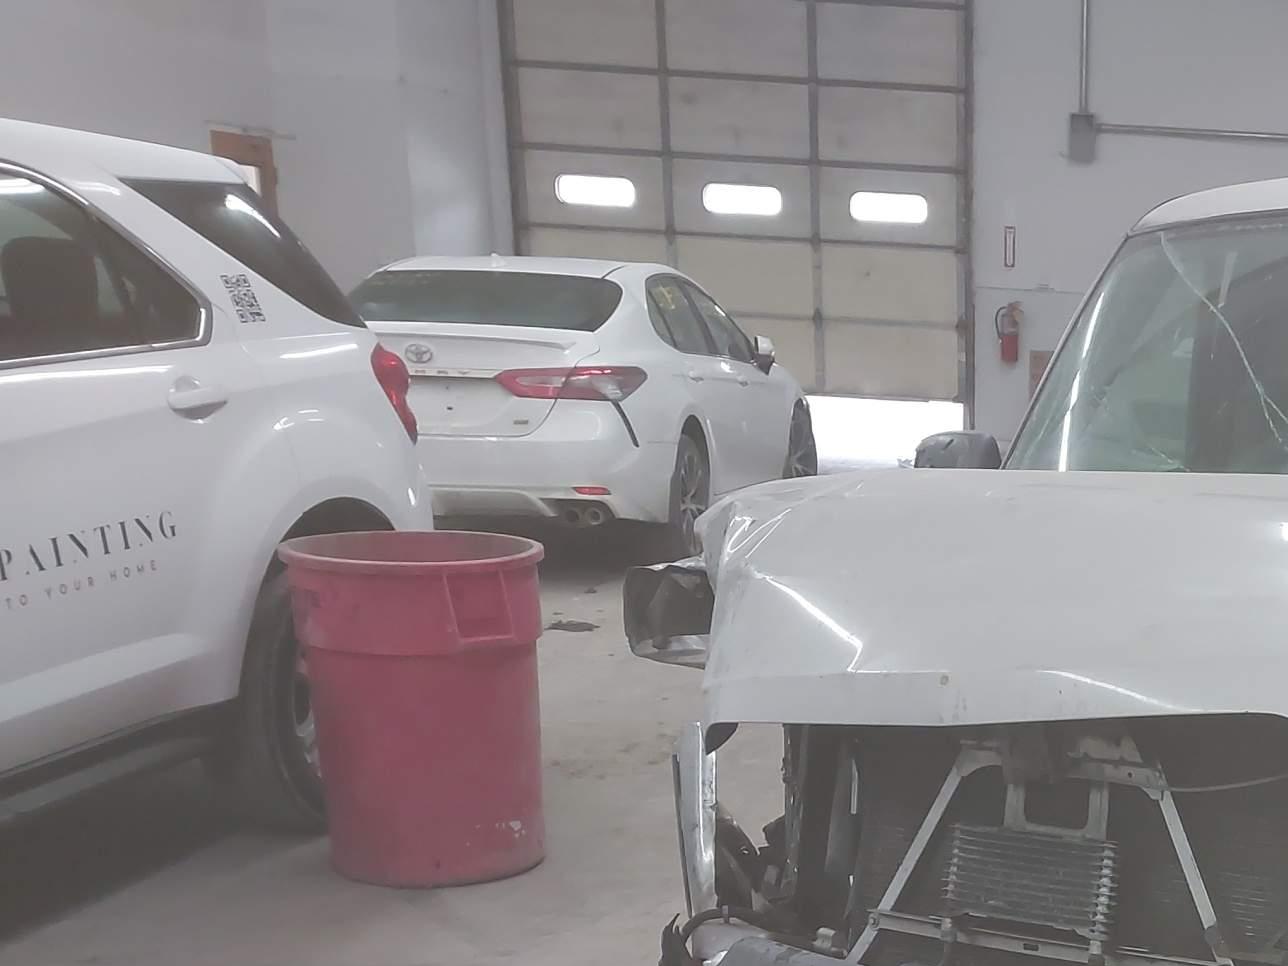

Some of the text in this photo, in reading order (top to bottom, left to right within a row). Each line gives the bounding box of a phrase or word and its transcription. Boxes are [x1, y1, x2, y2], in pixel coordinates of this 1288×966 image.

[0, 511, 176, 580] PAINTING
[5, 560, 158, 609] TO YOUR HOME
